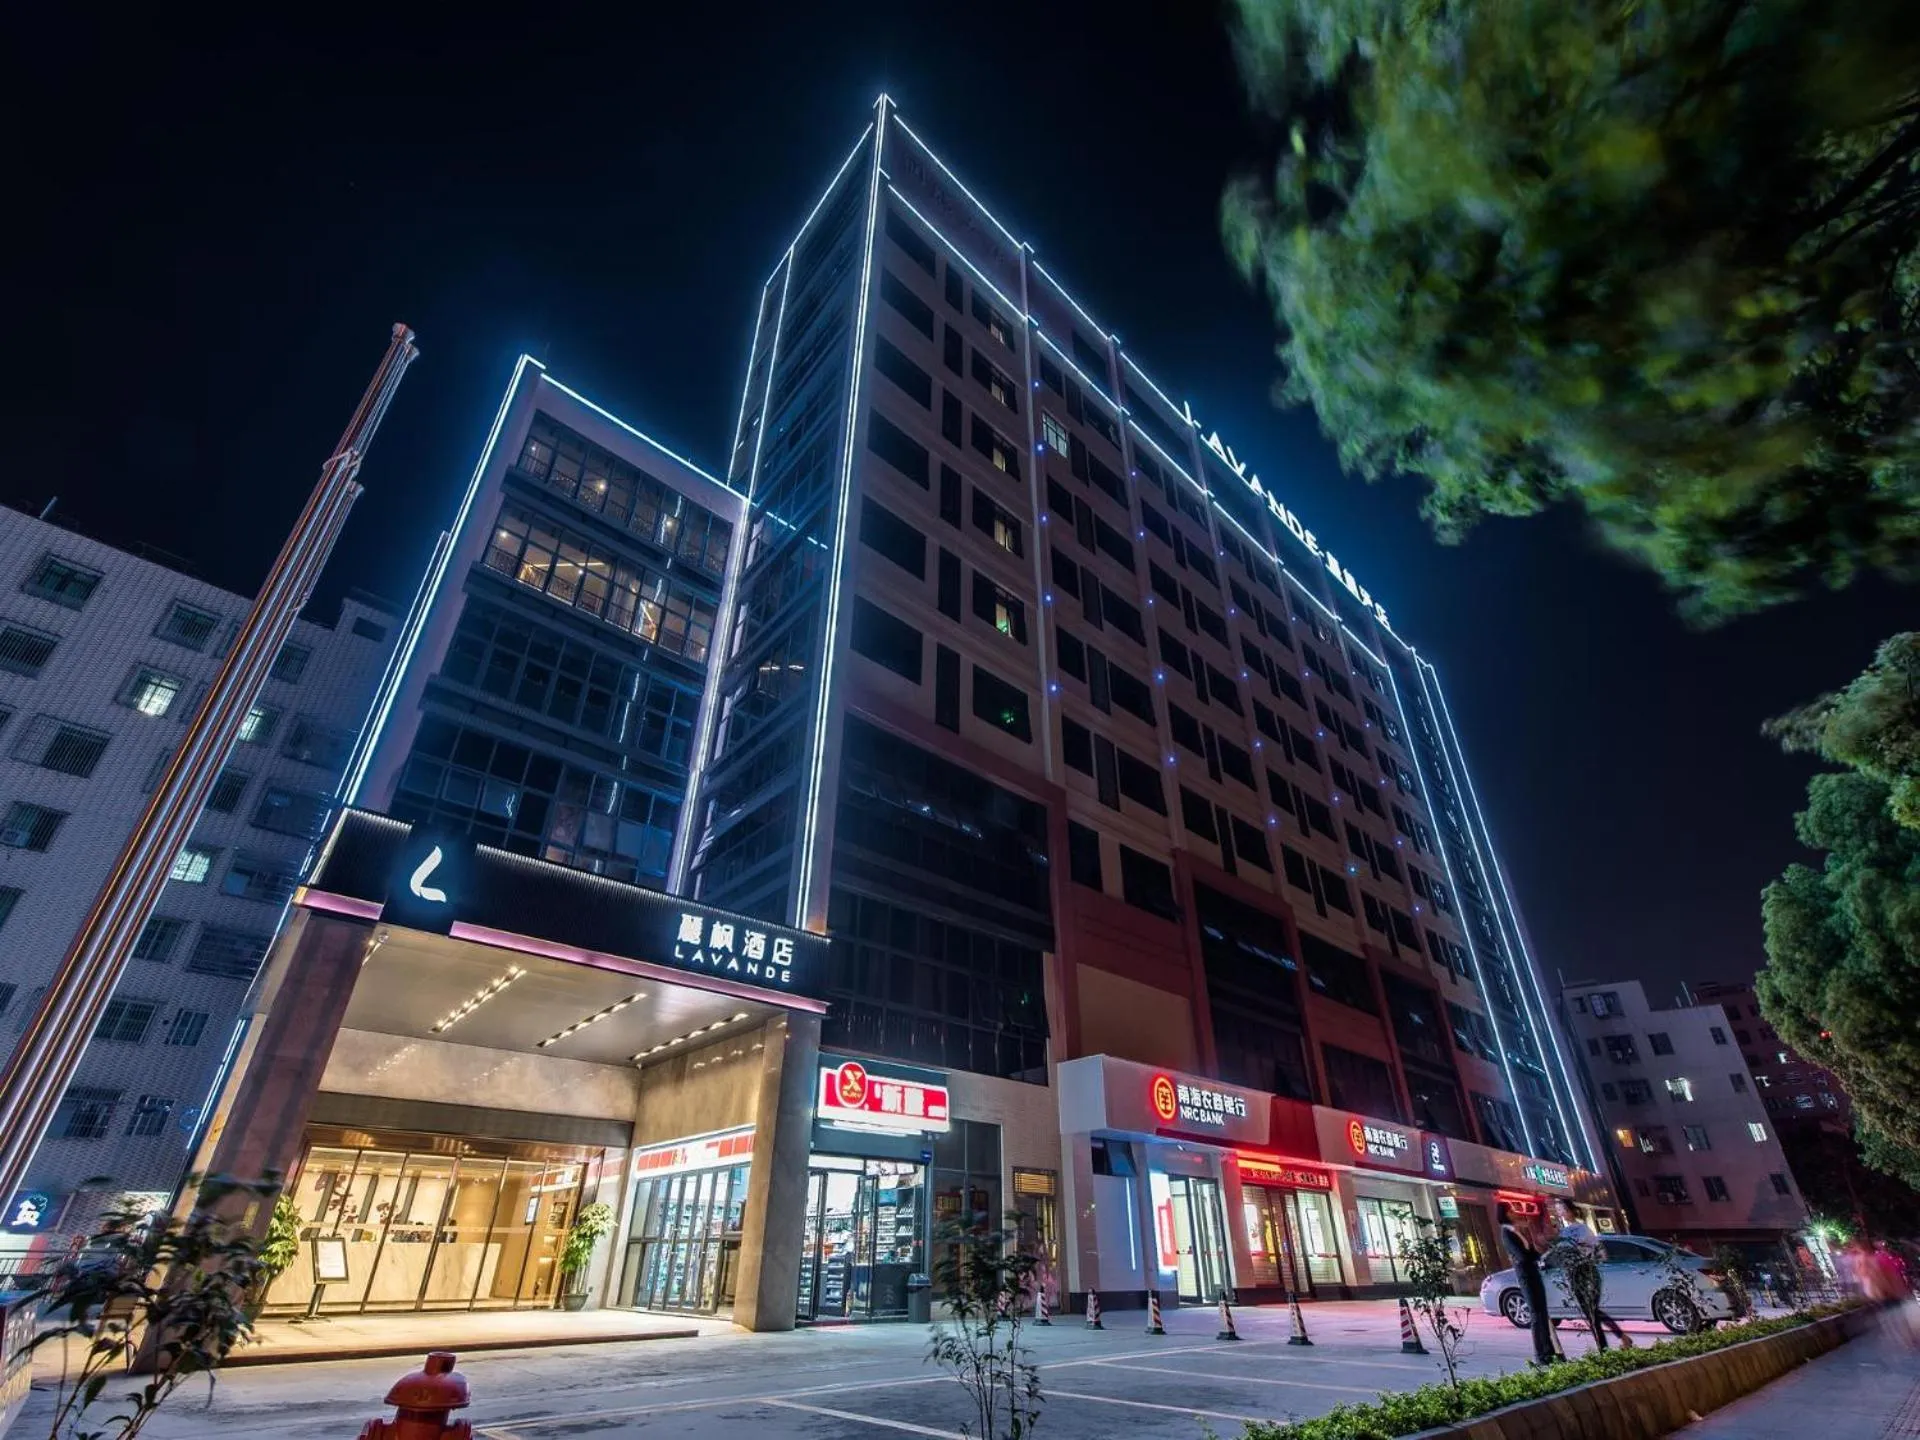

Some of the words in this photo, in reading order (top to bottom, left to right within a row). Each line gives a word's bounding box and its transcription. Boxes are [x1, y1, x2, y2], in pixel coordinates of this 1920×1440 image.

[674, 945, 791, 982] LAVANDE
[1180, 1106, 1200, 1121] NRC
[1200, 1110, 1225, 1126] BANK
